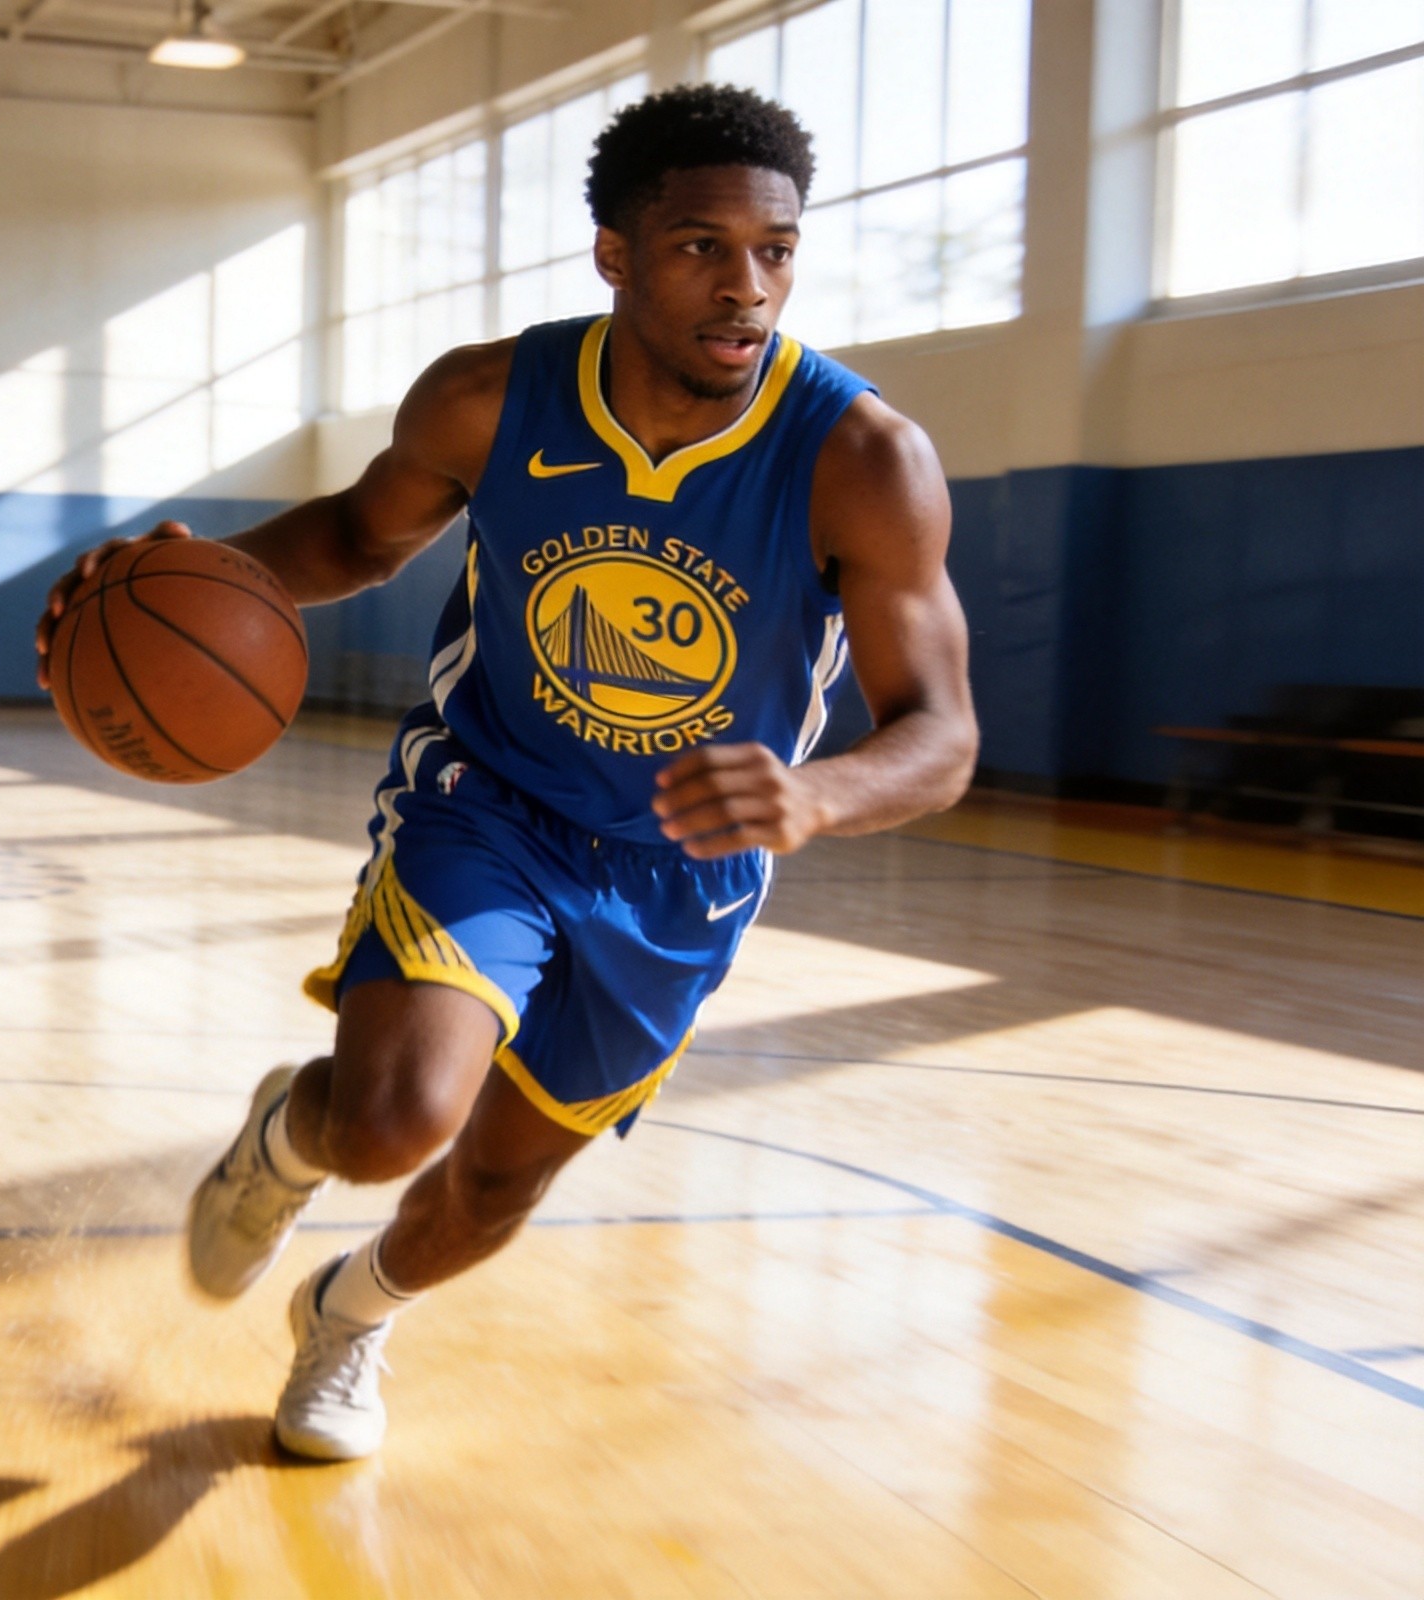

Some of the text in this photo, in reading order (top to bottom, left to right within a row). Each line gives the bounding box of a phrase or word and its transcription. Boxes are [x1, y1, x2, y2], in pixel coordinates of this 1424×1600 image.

[522, 525, 750, 612] GOLDEN STATE
[631, 596, 703, 648] 30
[533, 673, 734, 755] WARRIORS
